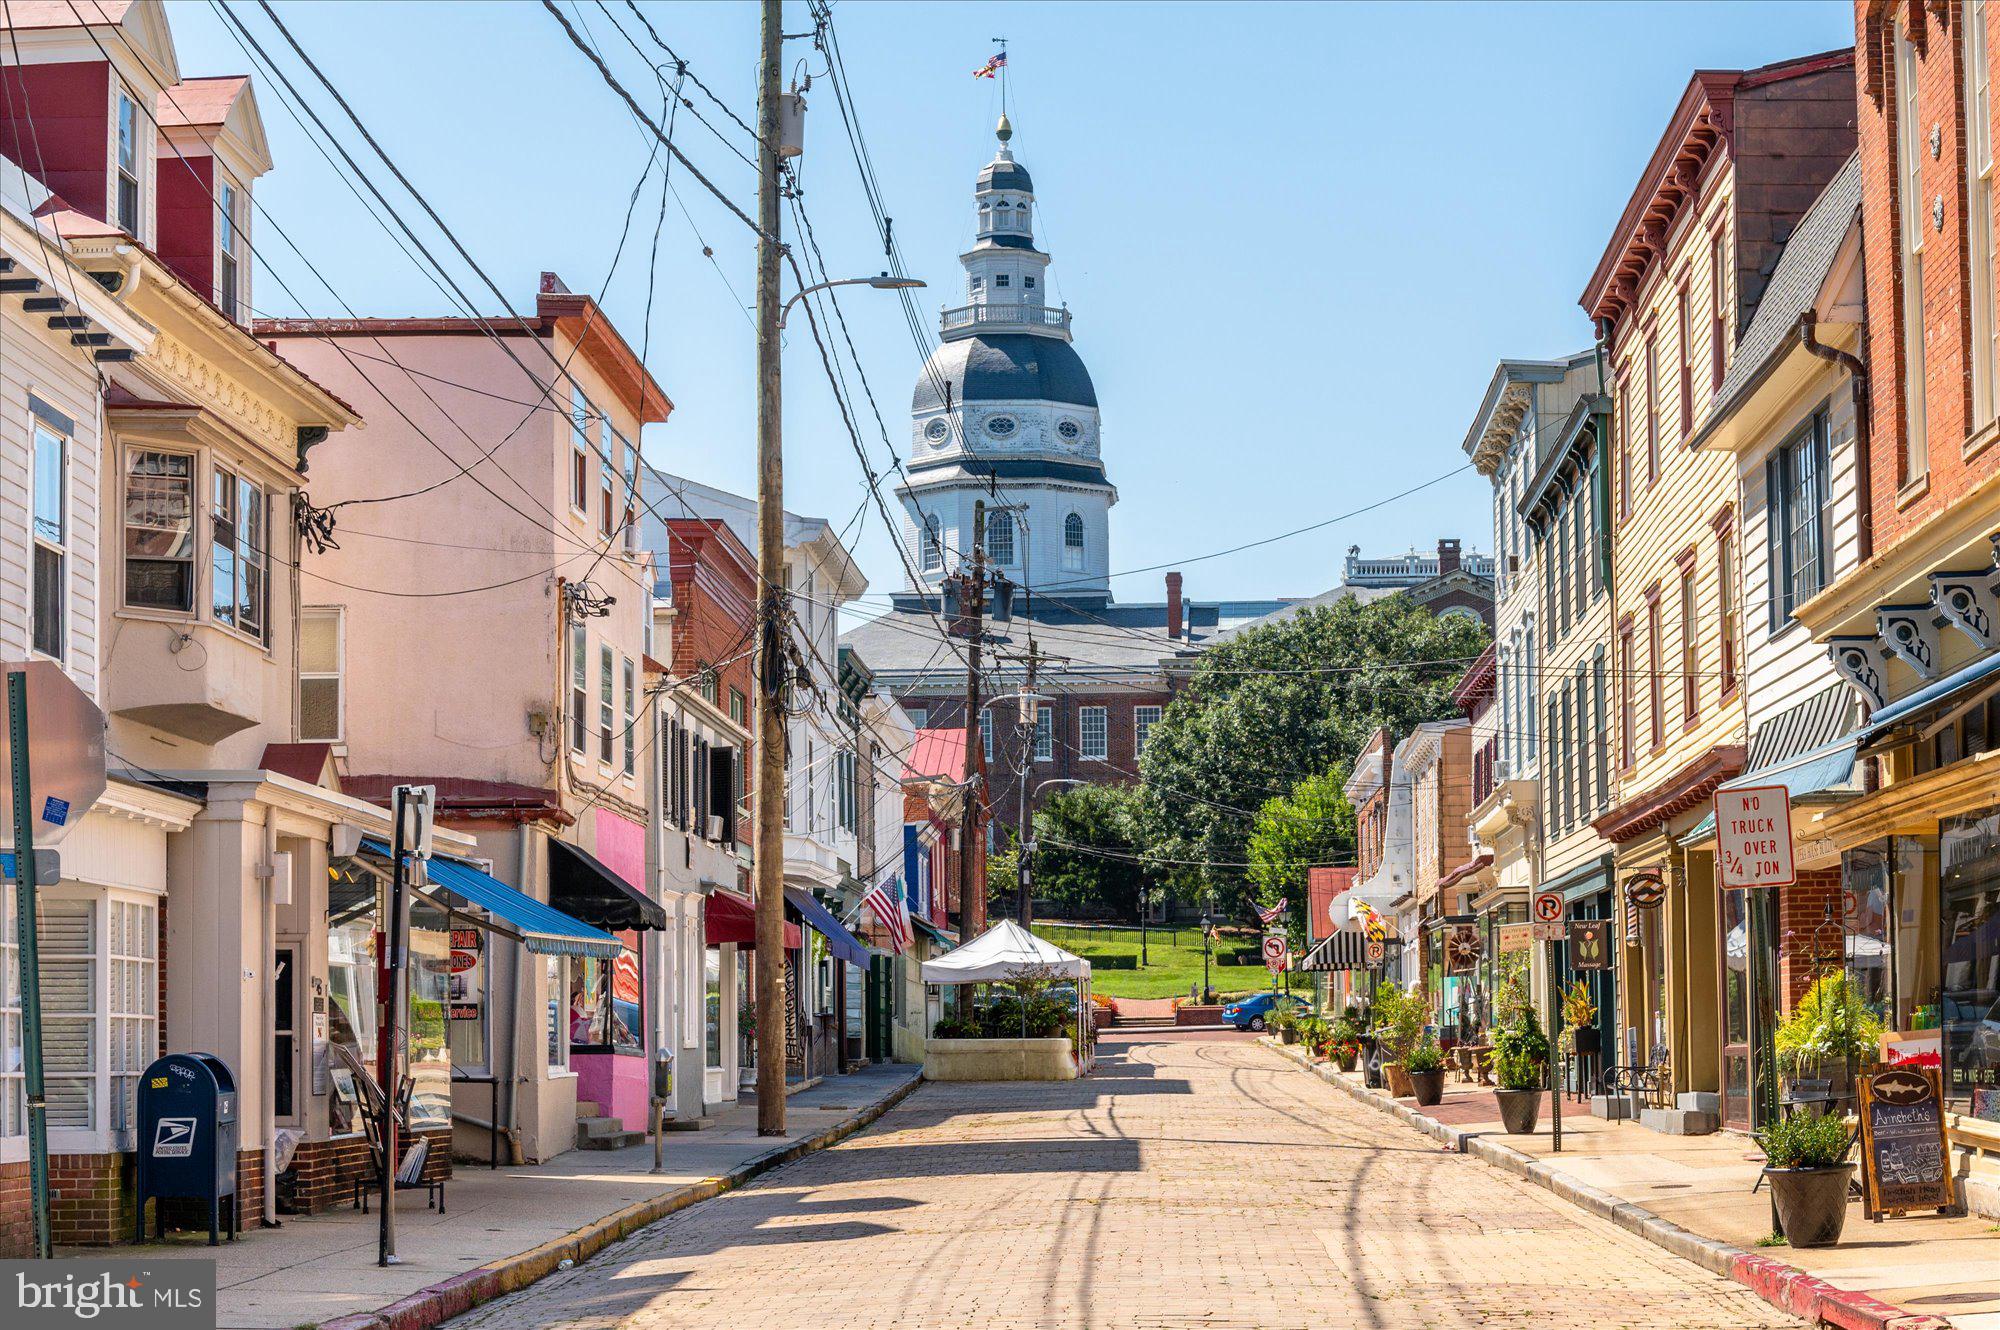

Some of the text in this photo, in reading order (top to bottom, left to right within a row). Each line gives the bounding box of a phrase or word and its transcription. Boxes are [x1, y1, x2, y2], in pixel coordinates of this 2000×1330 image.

[1742, 796, 1760, 811] NO
[1731, 818, 1774, 834] TRUCK
[1744, 840, 1776, 855] OVER
[1588, 922, 1601, 930] Leaf
[1577, 961, 1601, 969] Massage
[450, 1005, 477, 1018] ervice
